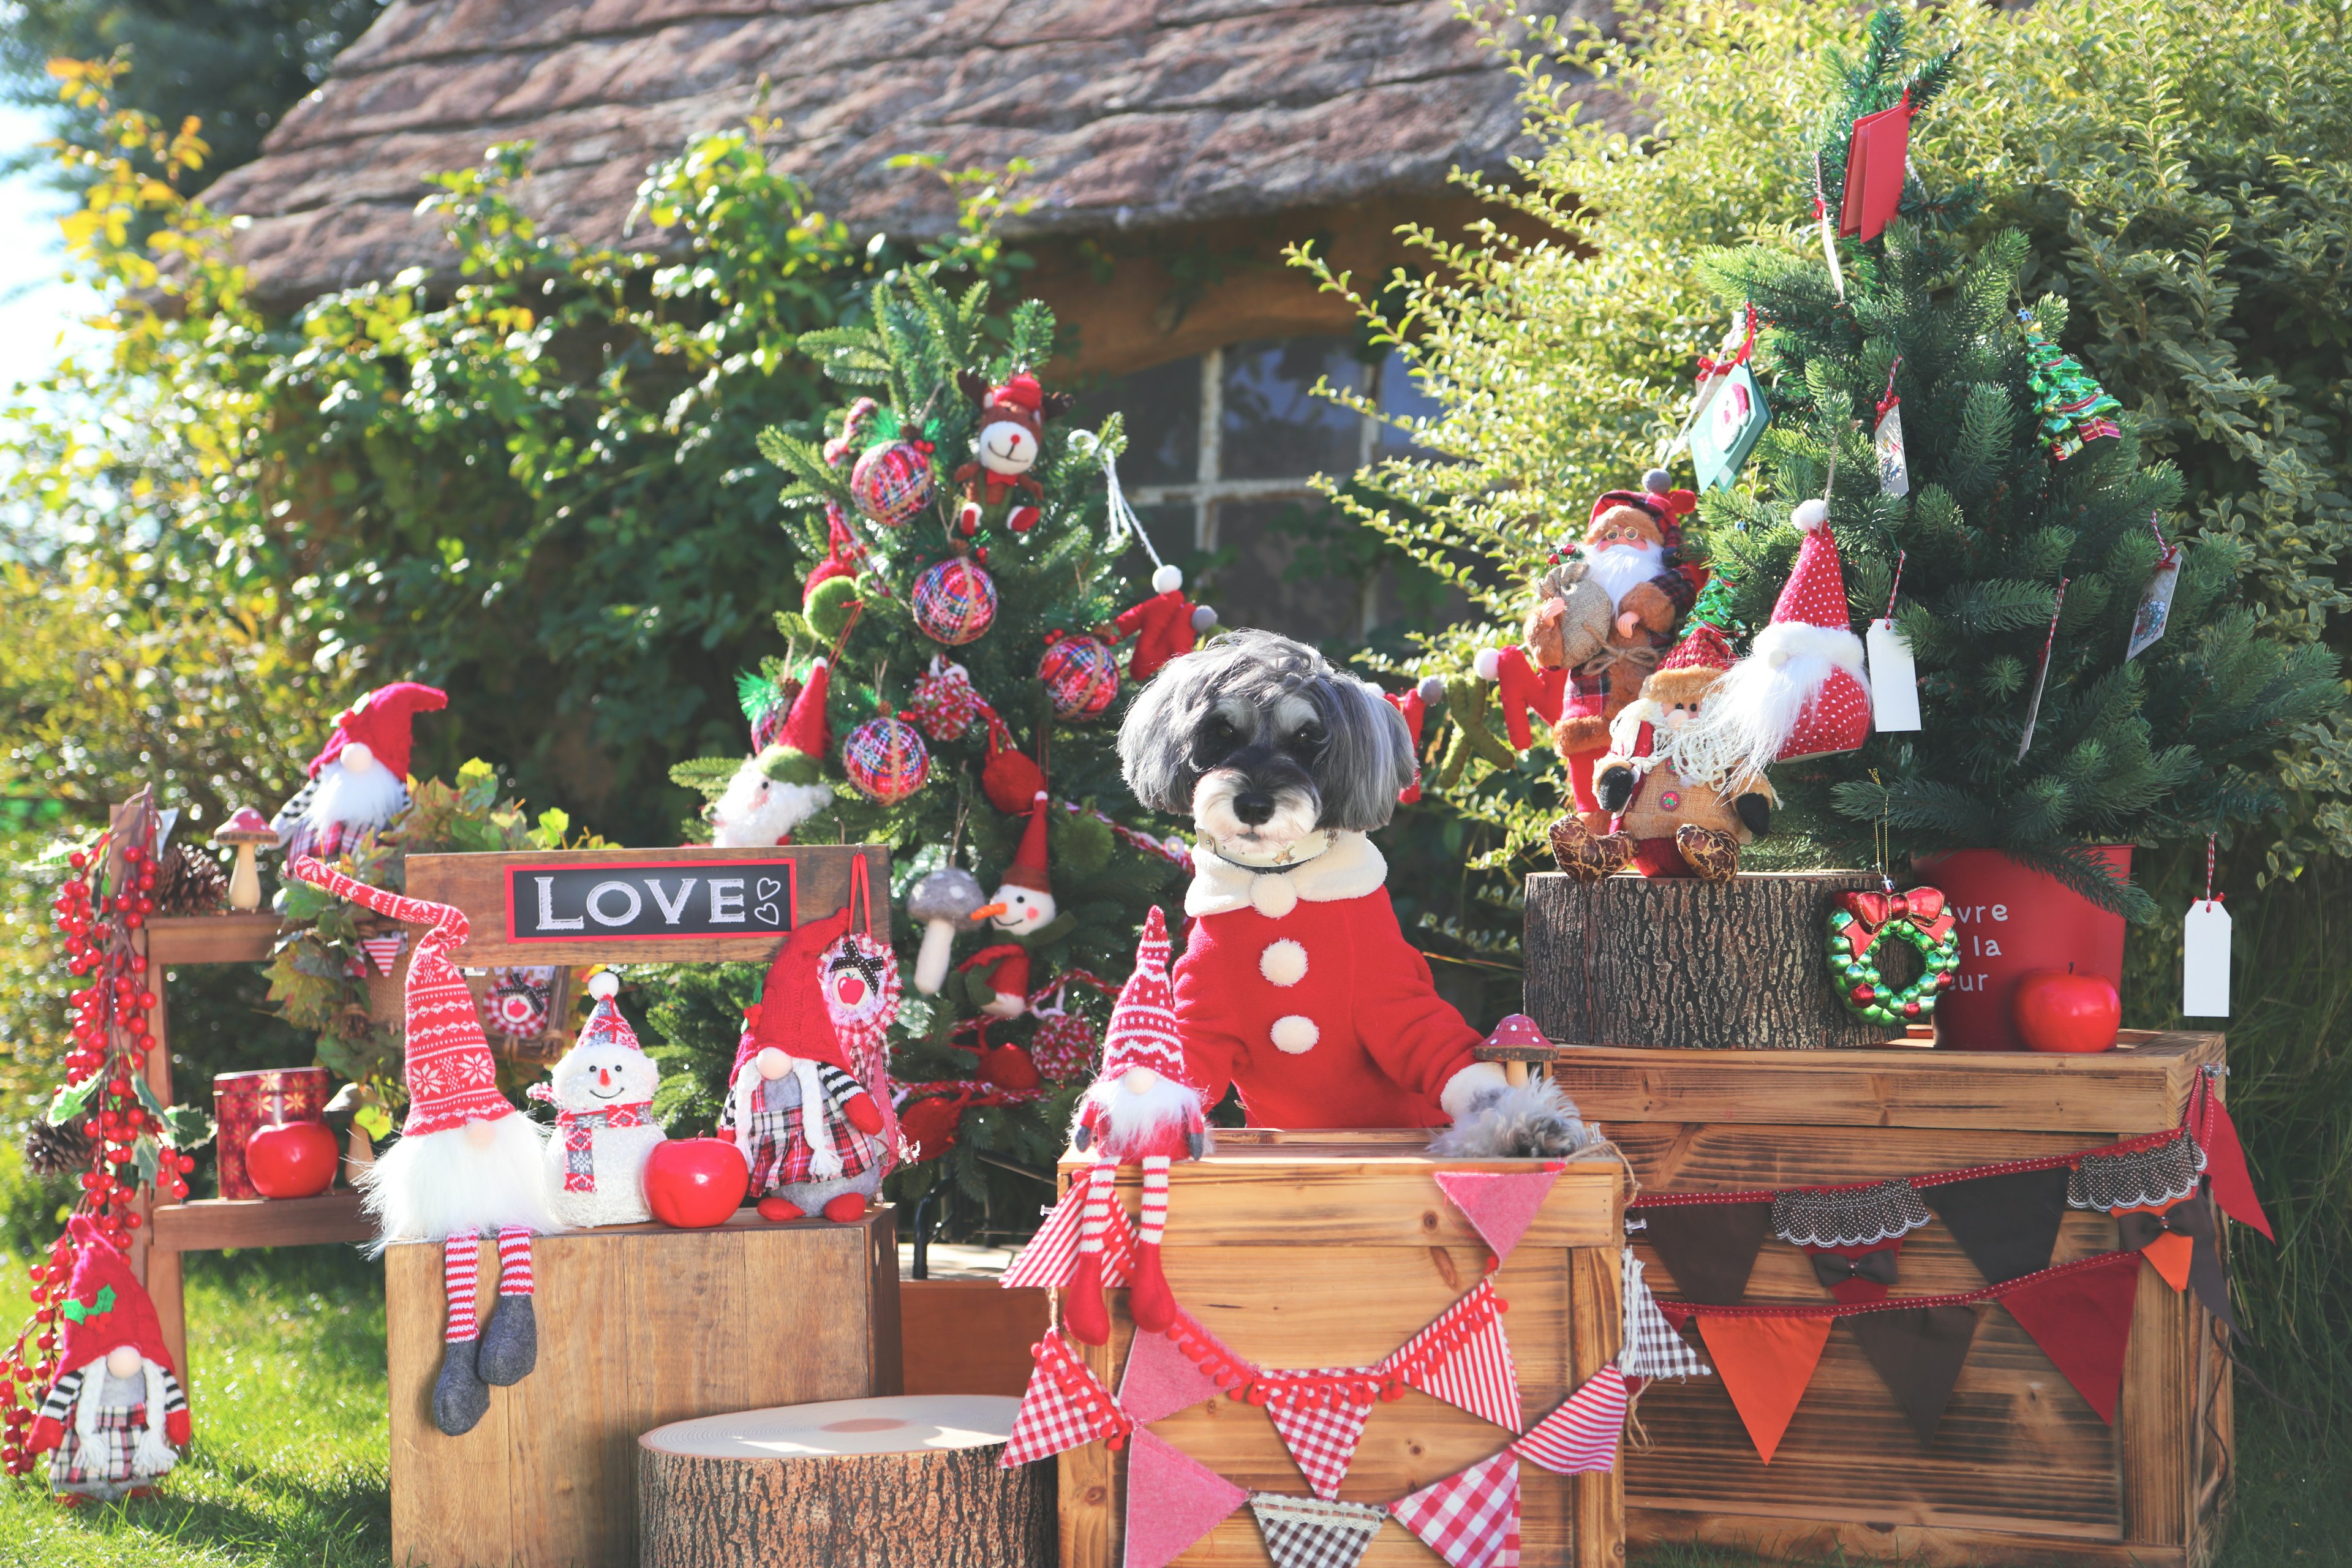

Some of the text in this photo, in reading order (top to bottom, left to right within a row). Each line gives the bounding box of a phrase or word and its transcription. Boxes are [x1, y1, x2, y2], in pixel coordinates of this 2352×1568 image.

[535, 876, 746, 930] LOVE
[1948, 902, 2008, 924] vre
[1973, 935, 2002, 957] la
